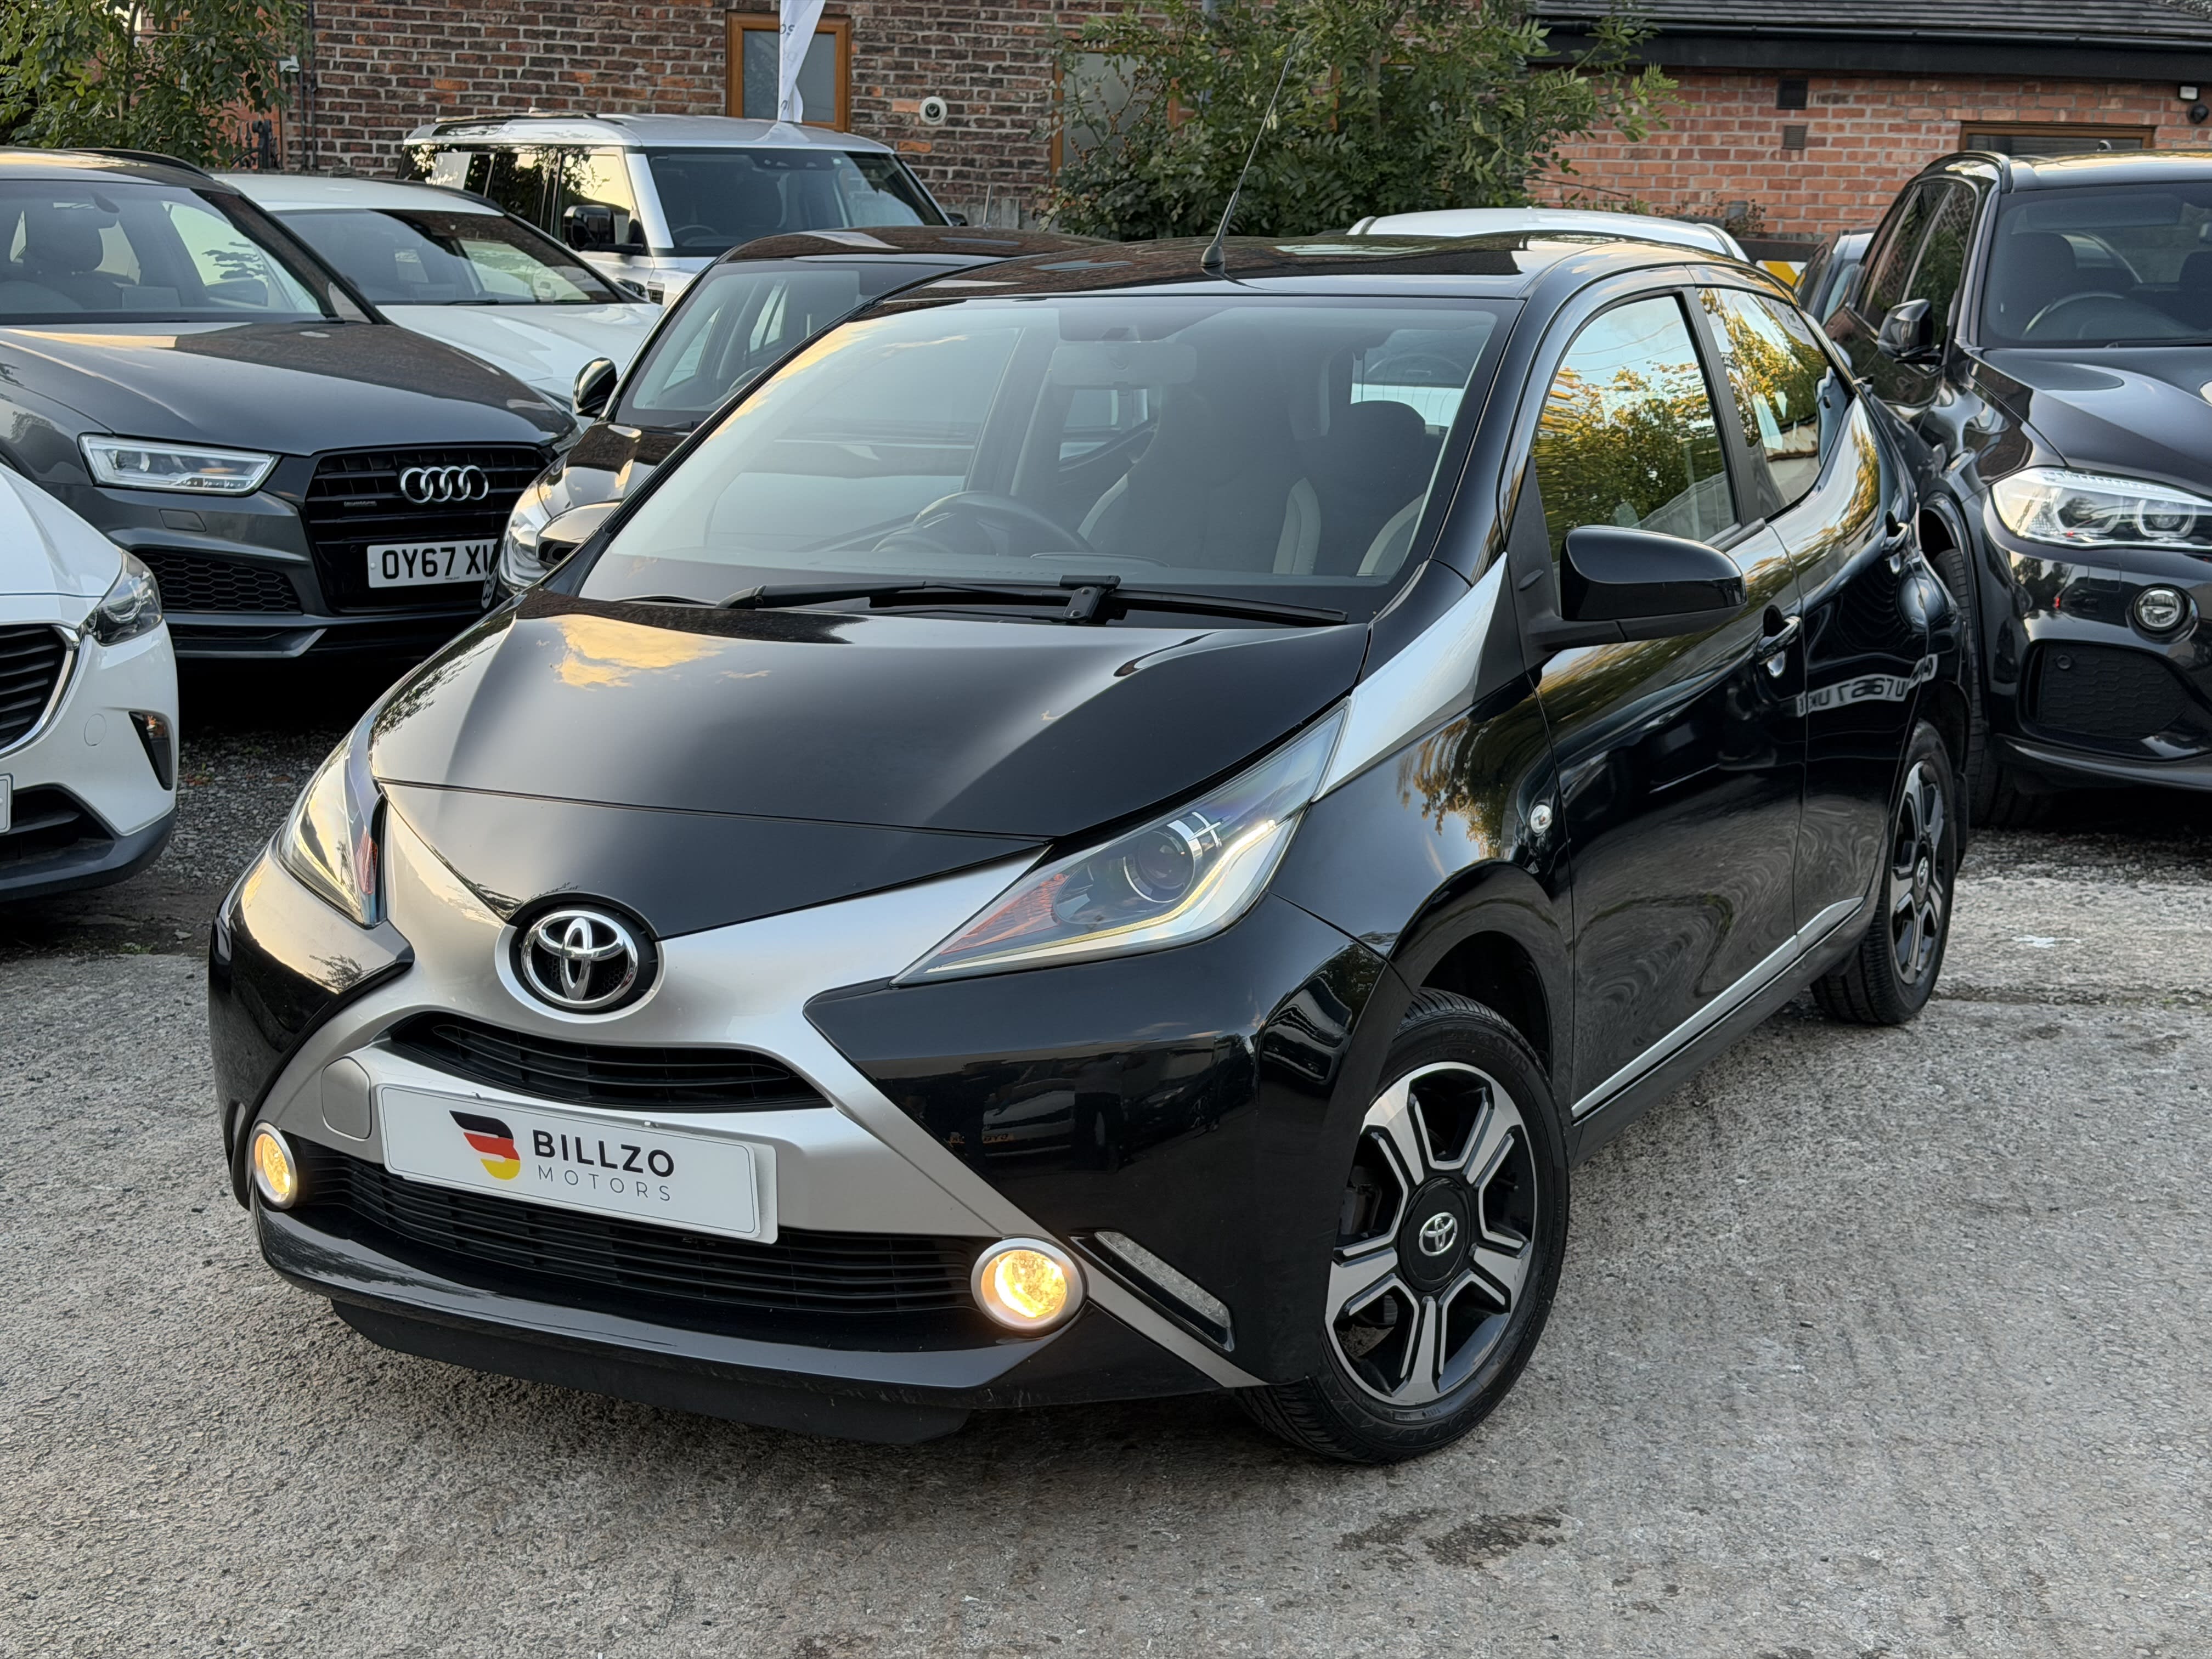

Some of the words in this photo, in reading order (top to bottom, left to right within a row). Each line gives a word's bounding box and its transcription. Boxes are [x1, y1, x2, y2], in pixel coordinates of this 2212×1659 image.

[382, 546, 456, 579] OY67
[532, 1129, 674, 1177] BILLZO
[538, 1165, 670, 1201] MOTORS
